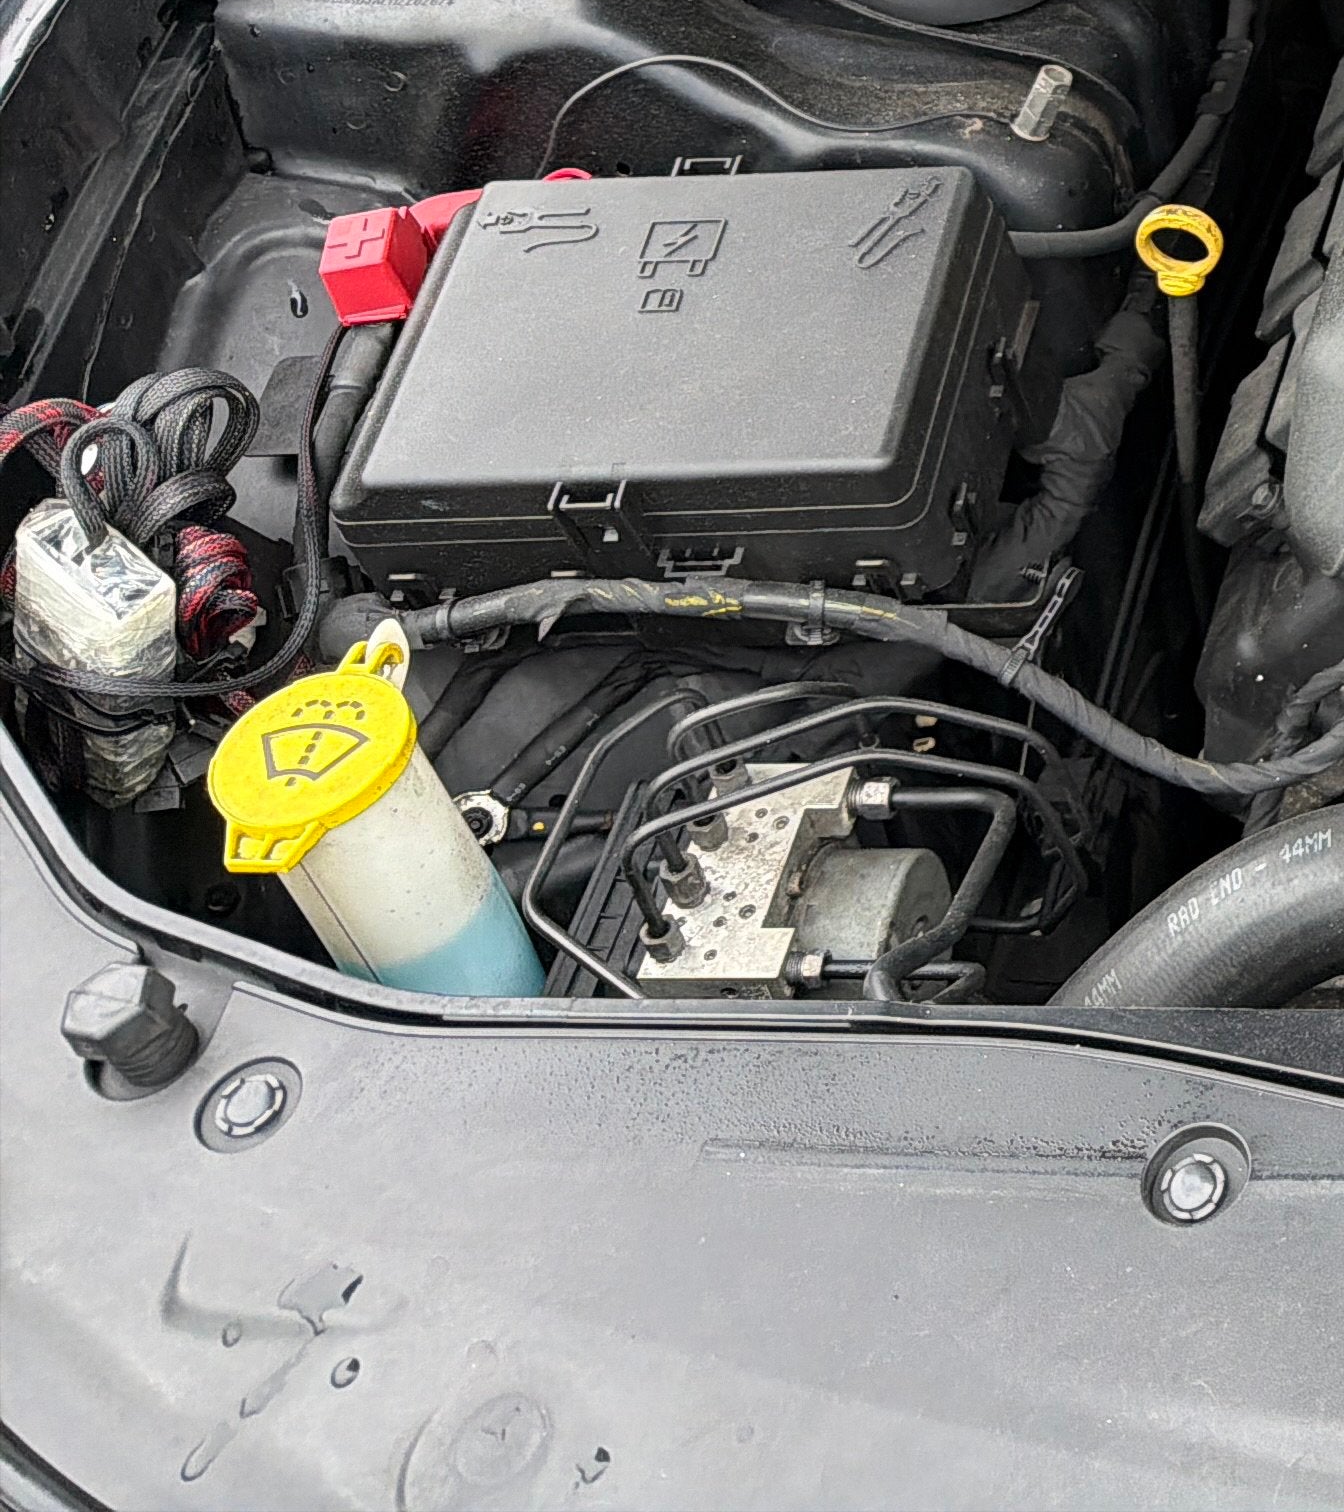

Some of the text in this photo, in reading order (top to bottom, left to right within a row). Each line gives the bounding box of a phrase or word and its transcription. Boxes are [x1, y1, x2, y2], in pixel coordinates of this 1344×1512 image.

[1167, 902, 1201, 937] RAD
[1210, 868, 1244, 904] END
[1278, 828, 1333, 864] 44MM
